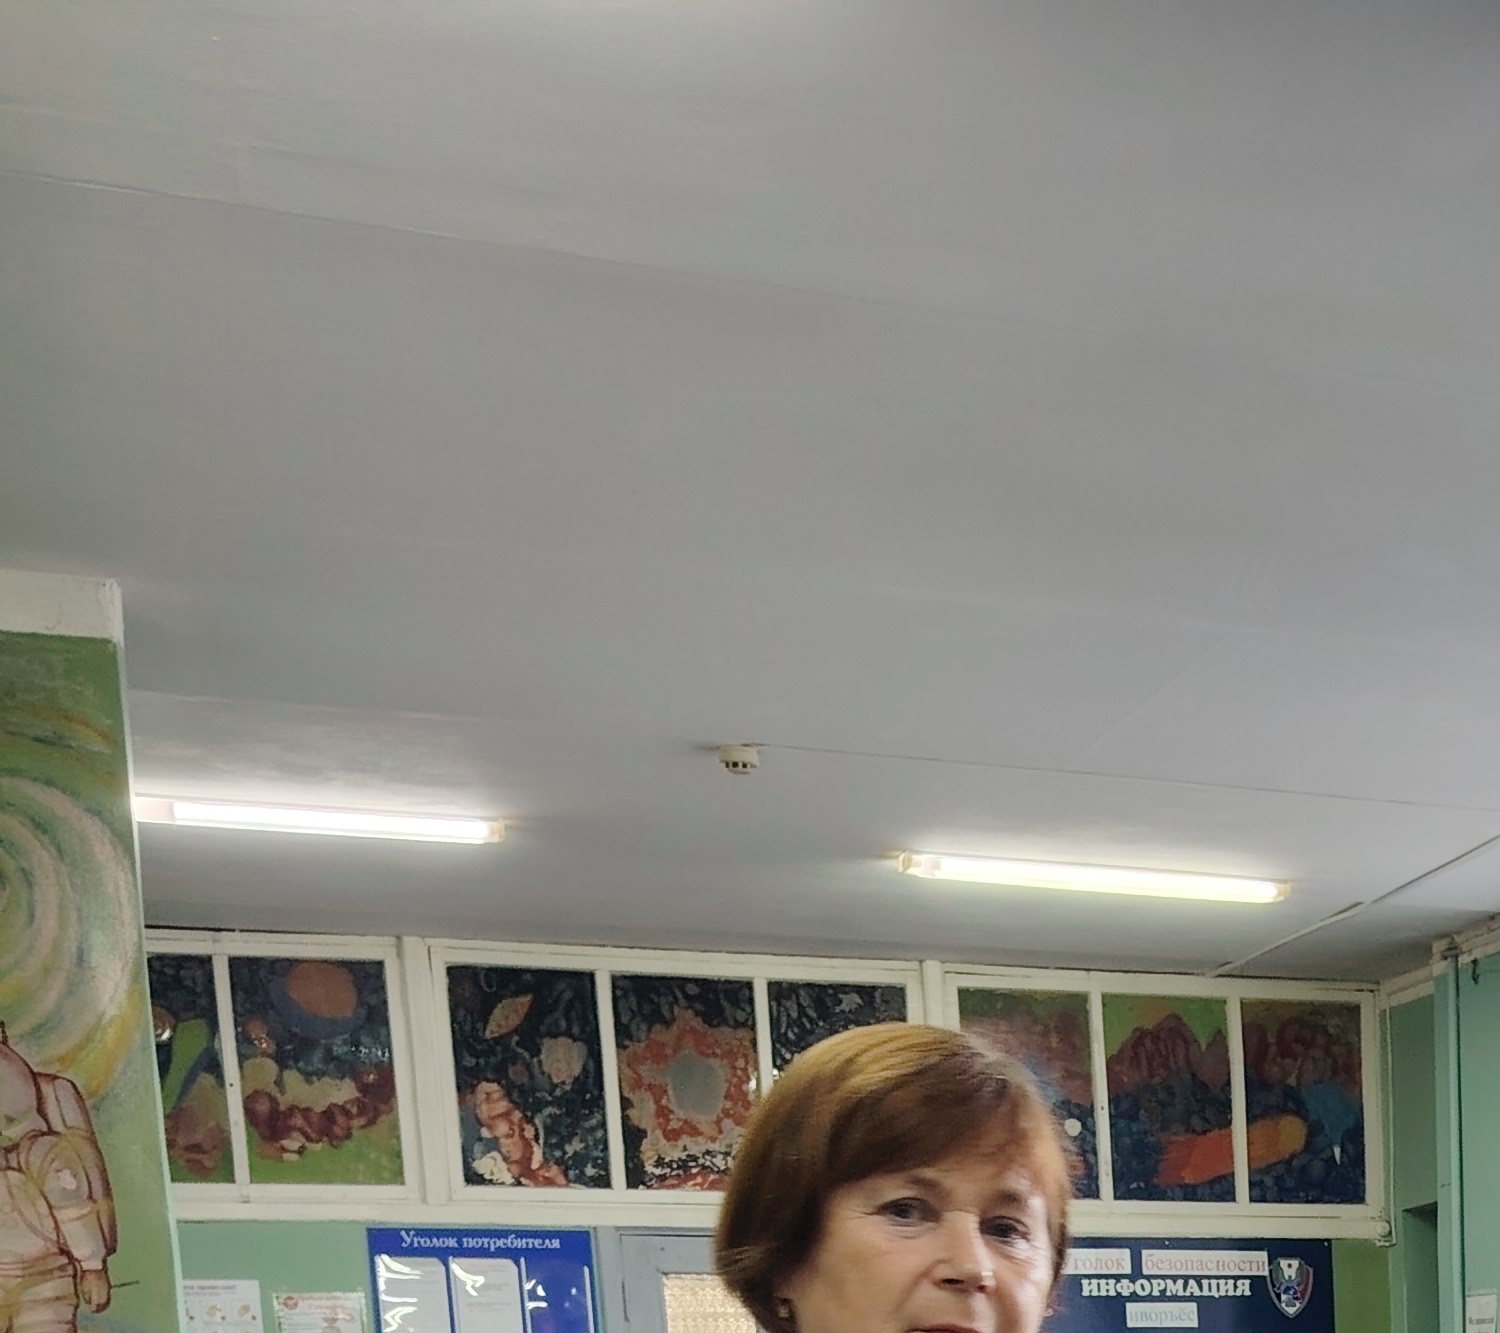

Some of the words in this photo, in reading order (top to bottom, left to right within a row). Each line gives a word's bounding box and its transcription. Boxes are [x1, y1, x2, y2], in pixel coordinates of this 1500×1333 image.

[400, 1230, 459, 1248] Уголок
[462, 1233, 561, 1252] потребителя
[1061, 1257, 1126, 1271] голок
[1144, 1254, 1267, 1273] безопасности
[1080, 1278, 1252, 1299] ИНФОРМАЦИЯ
